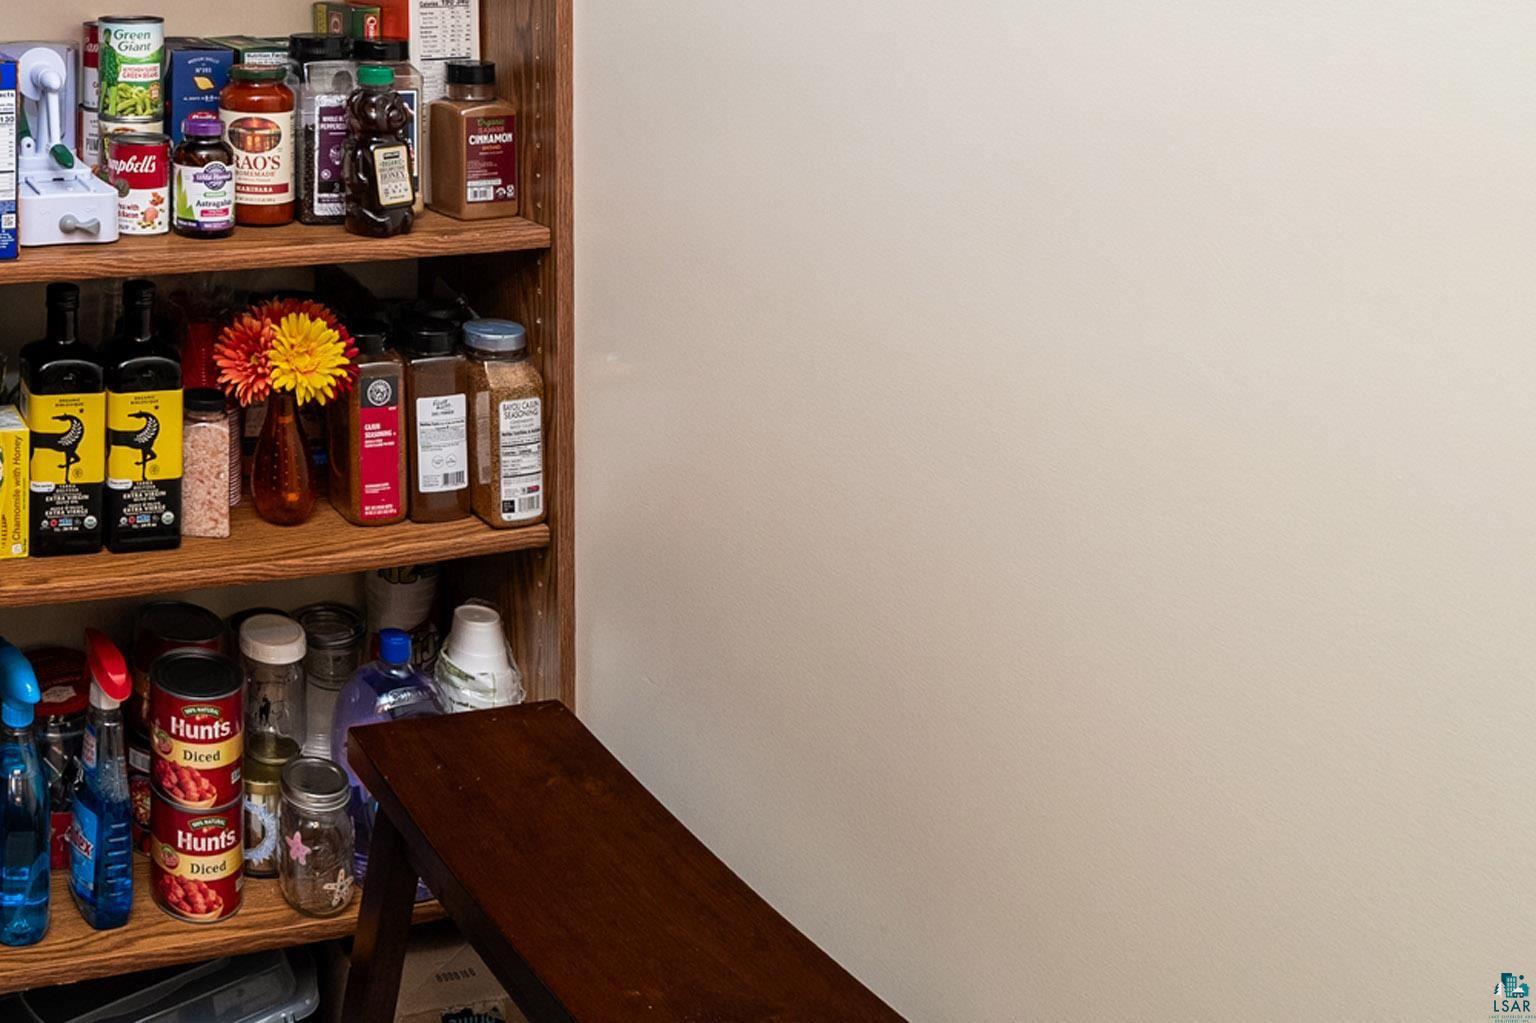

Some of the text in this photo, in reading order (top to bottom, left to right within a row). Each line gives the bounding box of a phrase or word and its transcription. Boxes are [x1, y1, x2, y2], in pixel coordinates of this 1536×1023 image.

[113, 28, 152, 41] Green
[117, 41, 152, 52] Giant
[468, 132, 513, 145] CINNAMON
[521, 400, 539, 410] CAJUN
[503, 408, 539, 421] SEASONING
[11, 435, 24, 541] Chamomile with Honey
[170, 715, 232, 741] Hunt's
[182, 749, 222, 763] Diced
[176, 828, 236, 853] Hunt's
[190, 861, 227, 876] Diced
